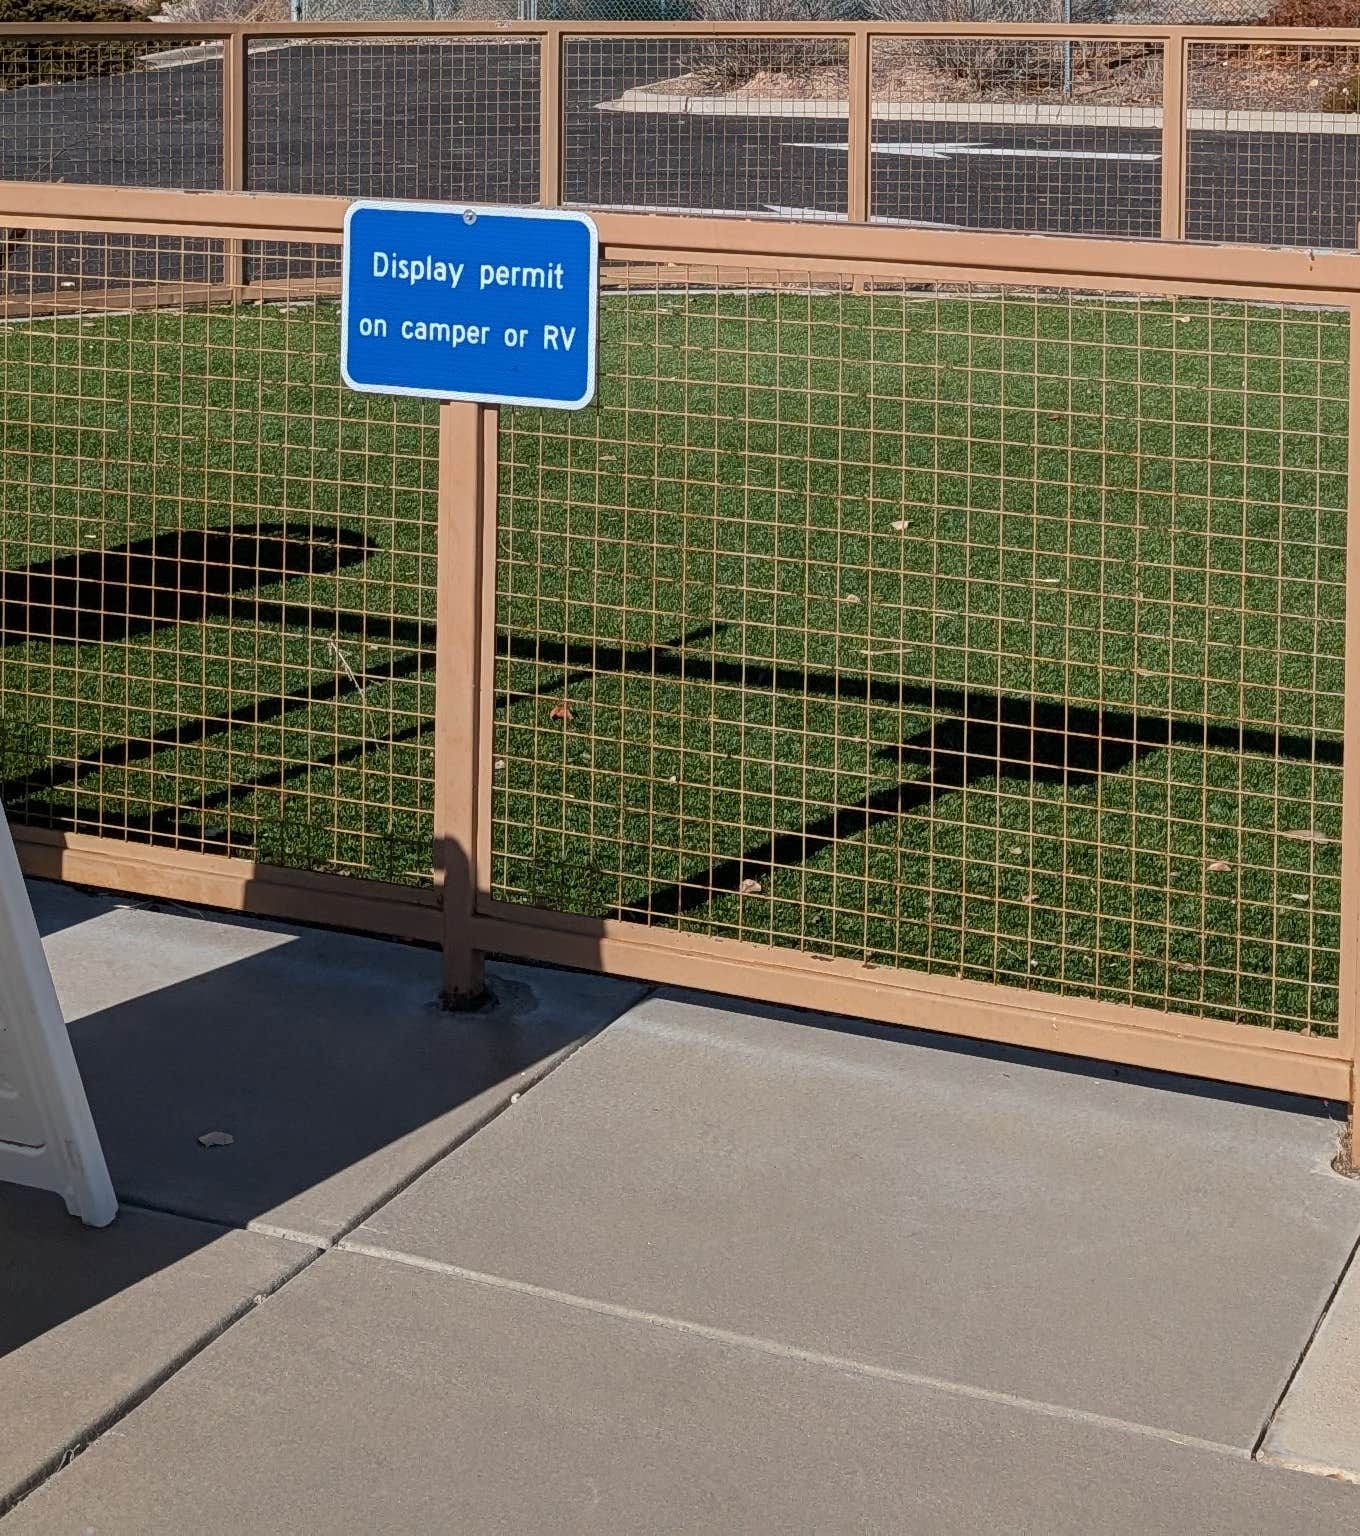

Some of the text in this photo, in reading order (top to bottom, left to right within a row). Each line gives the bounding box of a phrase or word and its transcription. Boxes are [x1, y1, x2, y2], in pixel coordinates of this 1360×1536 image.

[373, 252, 565, 290] Display permit
[359, 317, 576, 352] on camper or RV
